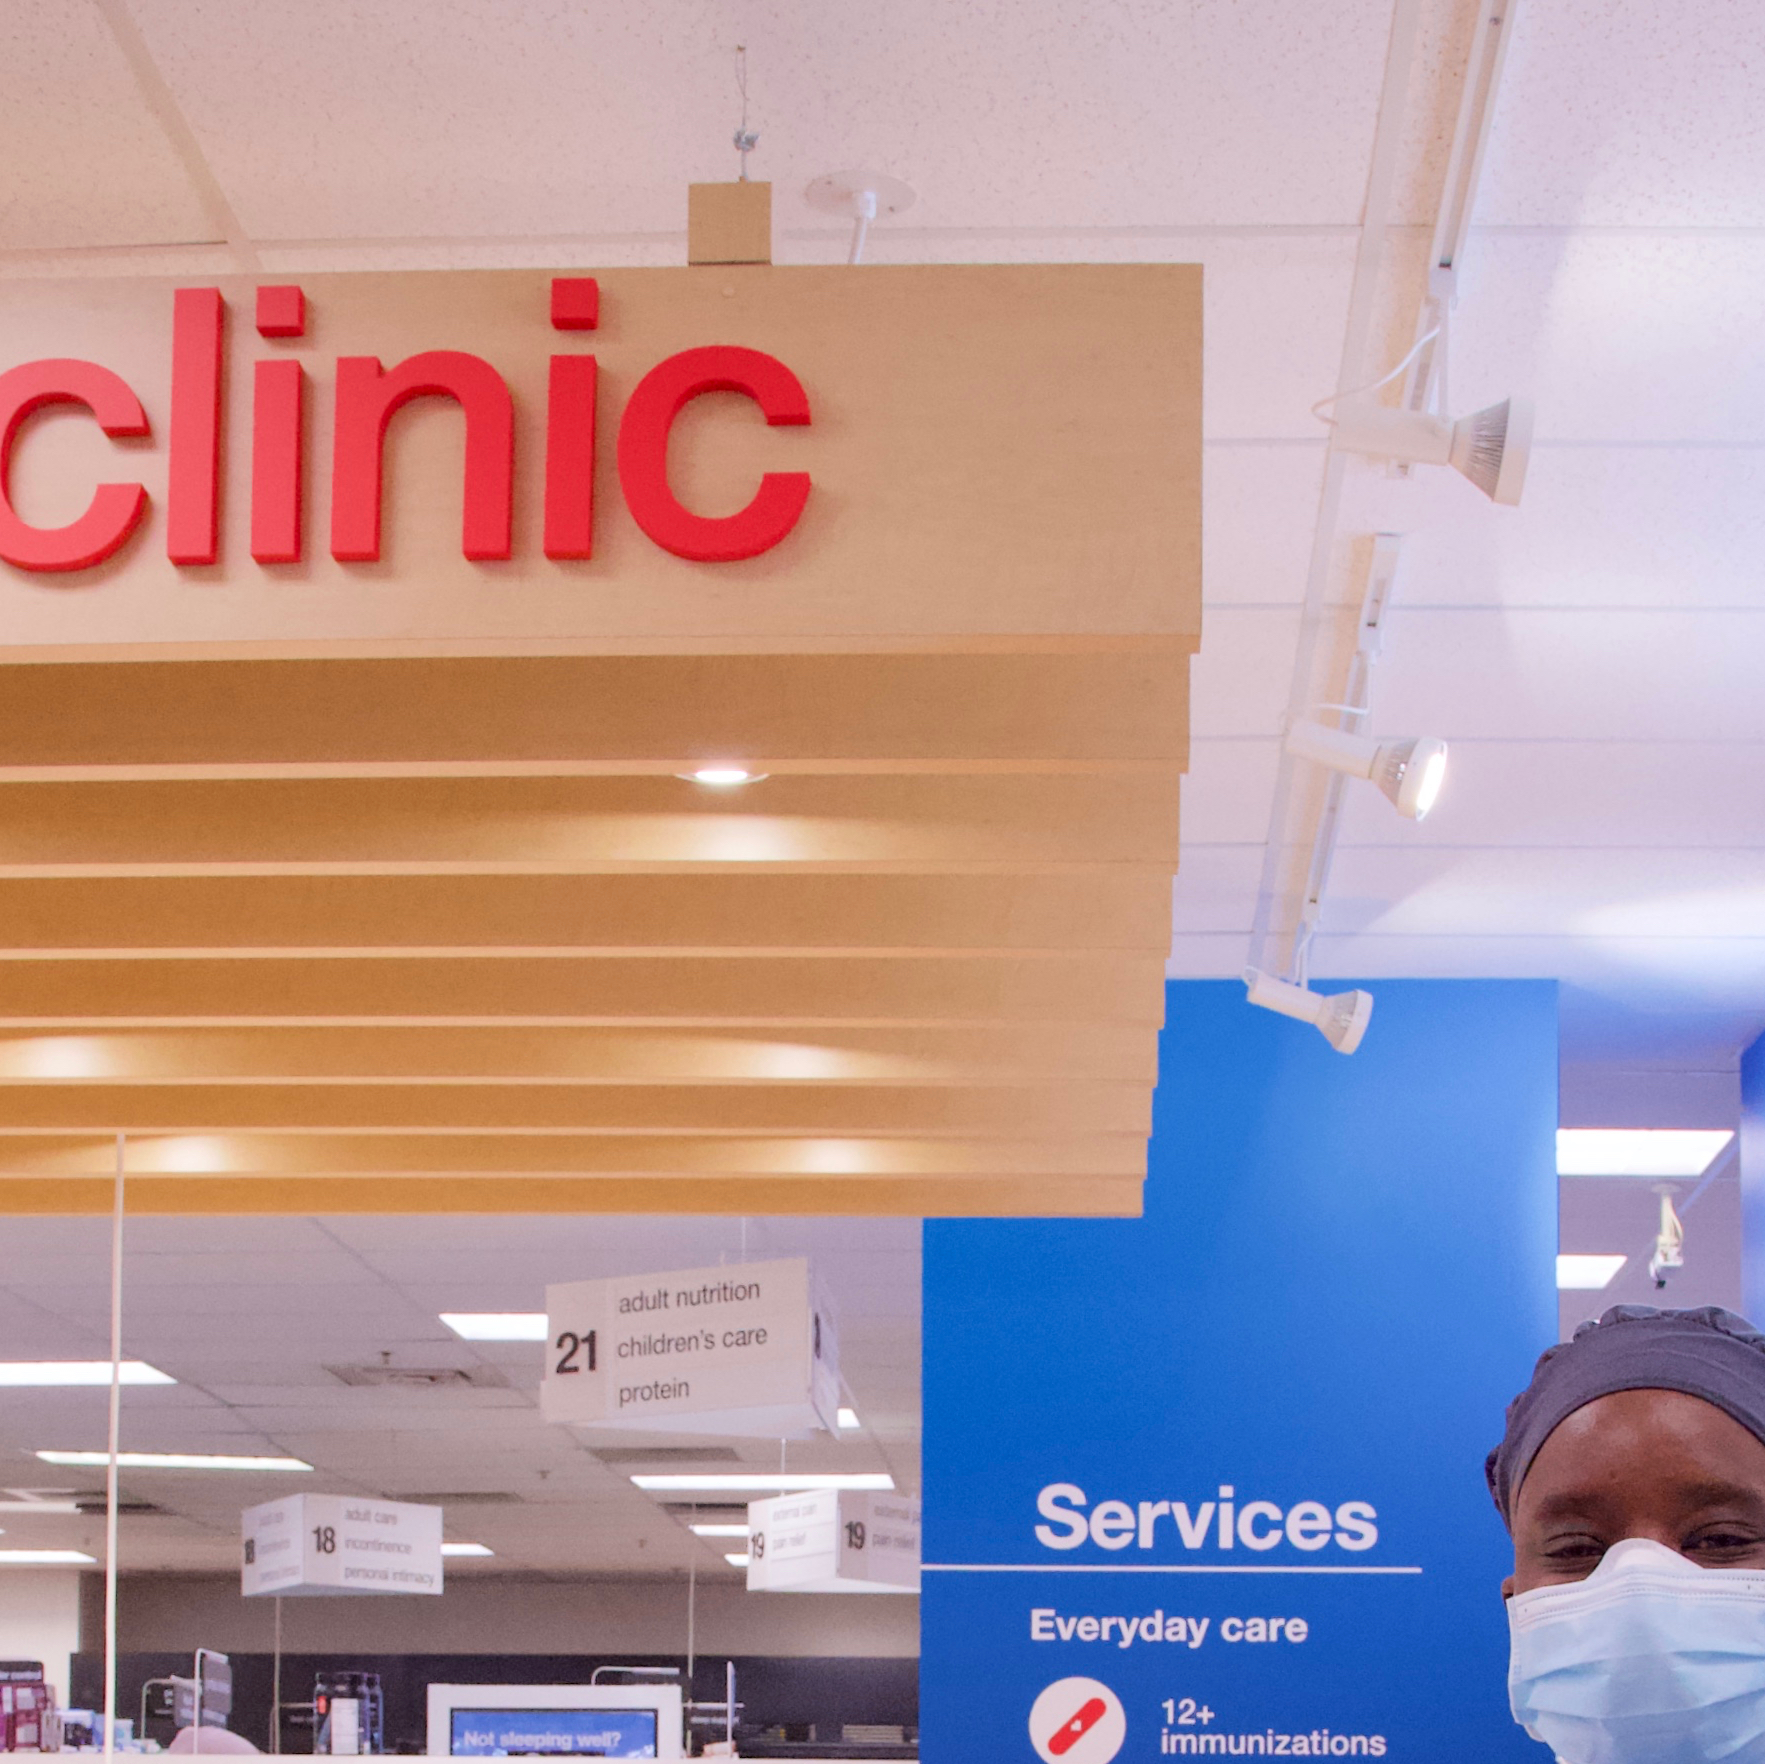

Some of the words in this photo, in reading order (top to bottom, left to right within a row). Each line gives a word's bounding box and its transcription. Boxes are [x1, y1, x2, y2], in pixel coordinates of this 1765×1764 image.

[619, 1289, 669, 1314] adult
[676, 1280, 761, 1308] nutrition
[555, 1329, 597, 1374] 21
[617, 1328, 716, 1358] children's
[722, 1328, 768, 1348] care
[619, 1379, 690, 1407] protein
[1034, 1483, 1379, 1551] Services
[311, 1526, 335, 1554] 18
[751, 1532, 765, 1559] 19
[845, 1521, 866, 1550] 19
[1030, 1608, 1208, 1648] Everyday
[1220, 1617, 1309, 1643] care
[1161, 1698, 1215, 1726] 12+
[464, 1731, 495, 1747] Not
[500, 1731, 572, 1751] sleeping
[577, 1731, 621, 1748] well?
[1160, 1729, 1387, 1757] immunizations
